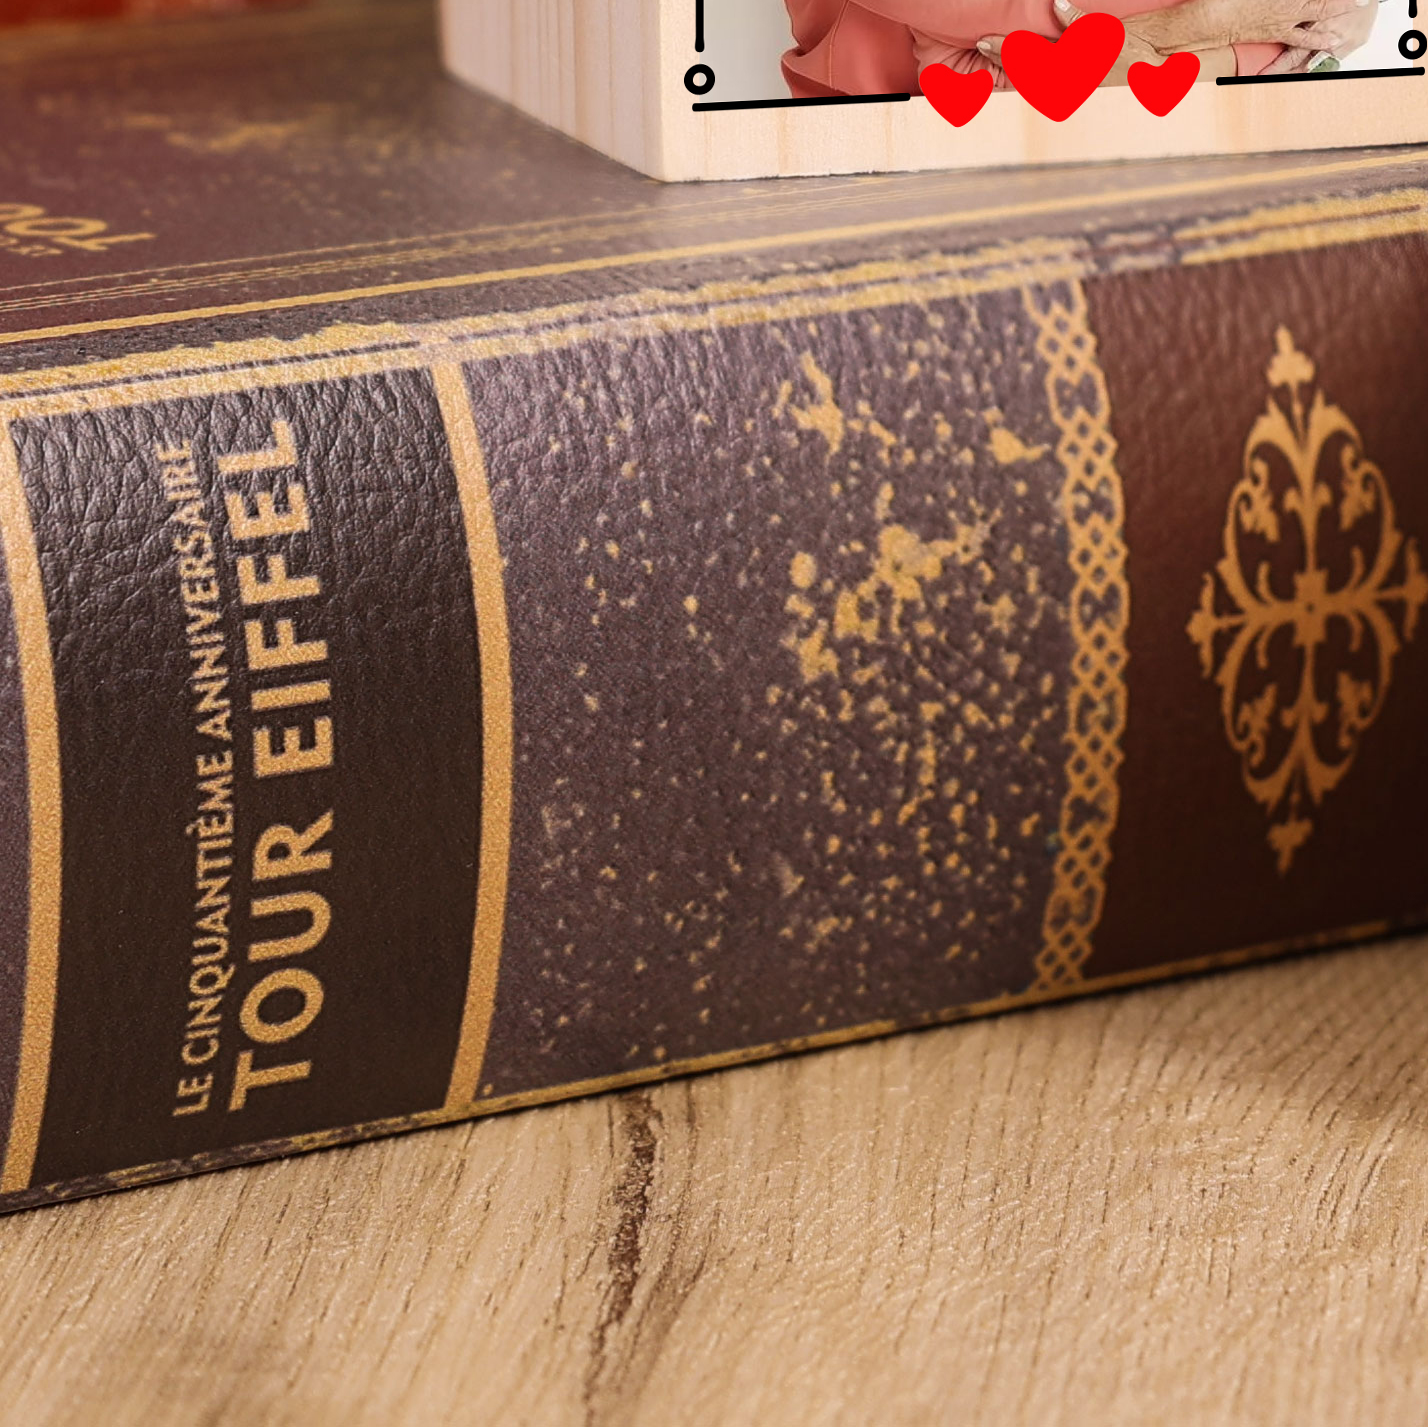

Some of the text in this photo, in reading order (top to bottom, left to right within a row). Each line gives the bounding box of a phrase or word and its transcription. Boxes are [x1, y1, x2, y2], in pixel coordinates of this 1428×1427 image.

[155, 439, 235, 1116] LE CINQUANTIÈME ANNIVERSAIRE
[217, 421, 333, 1111] TOUR EIFFEL
